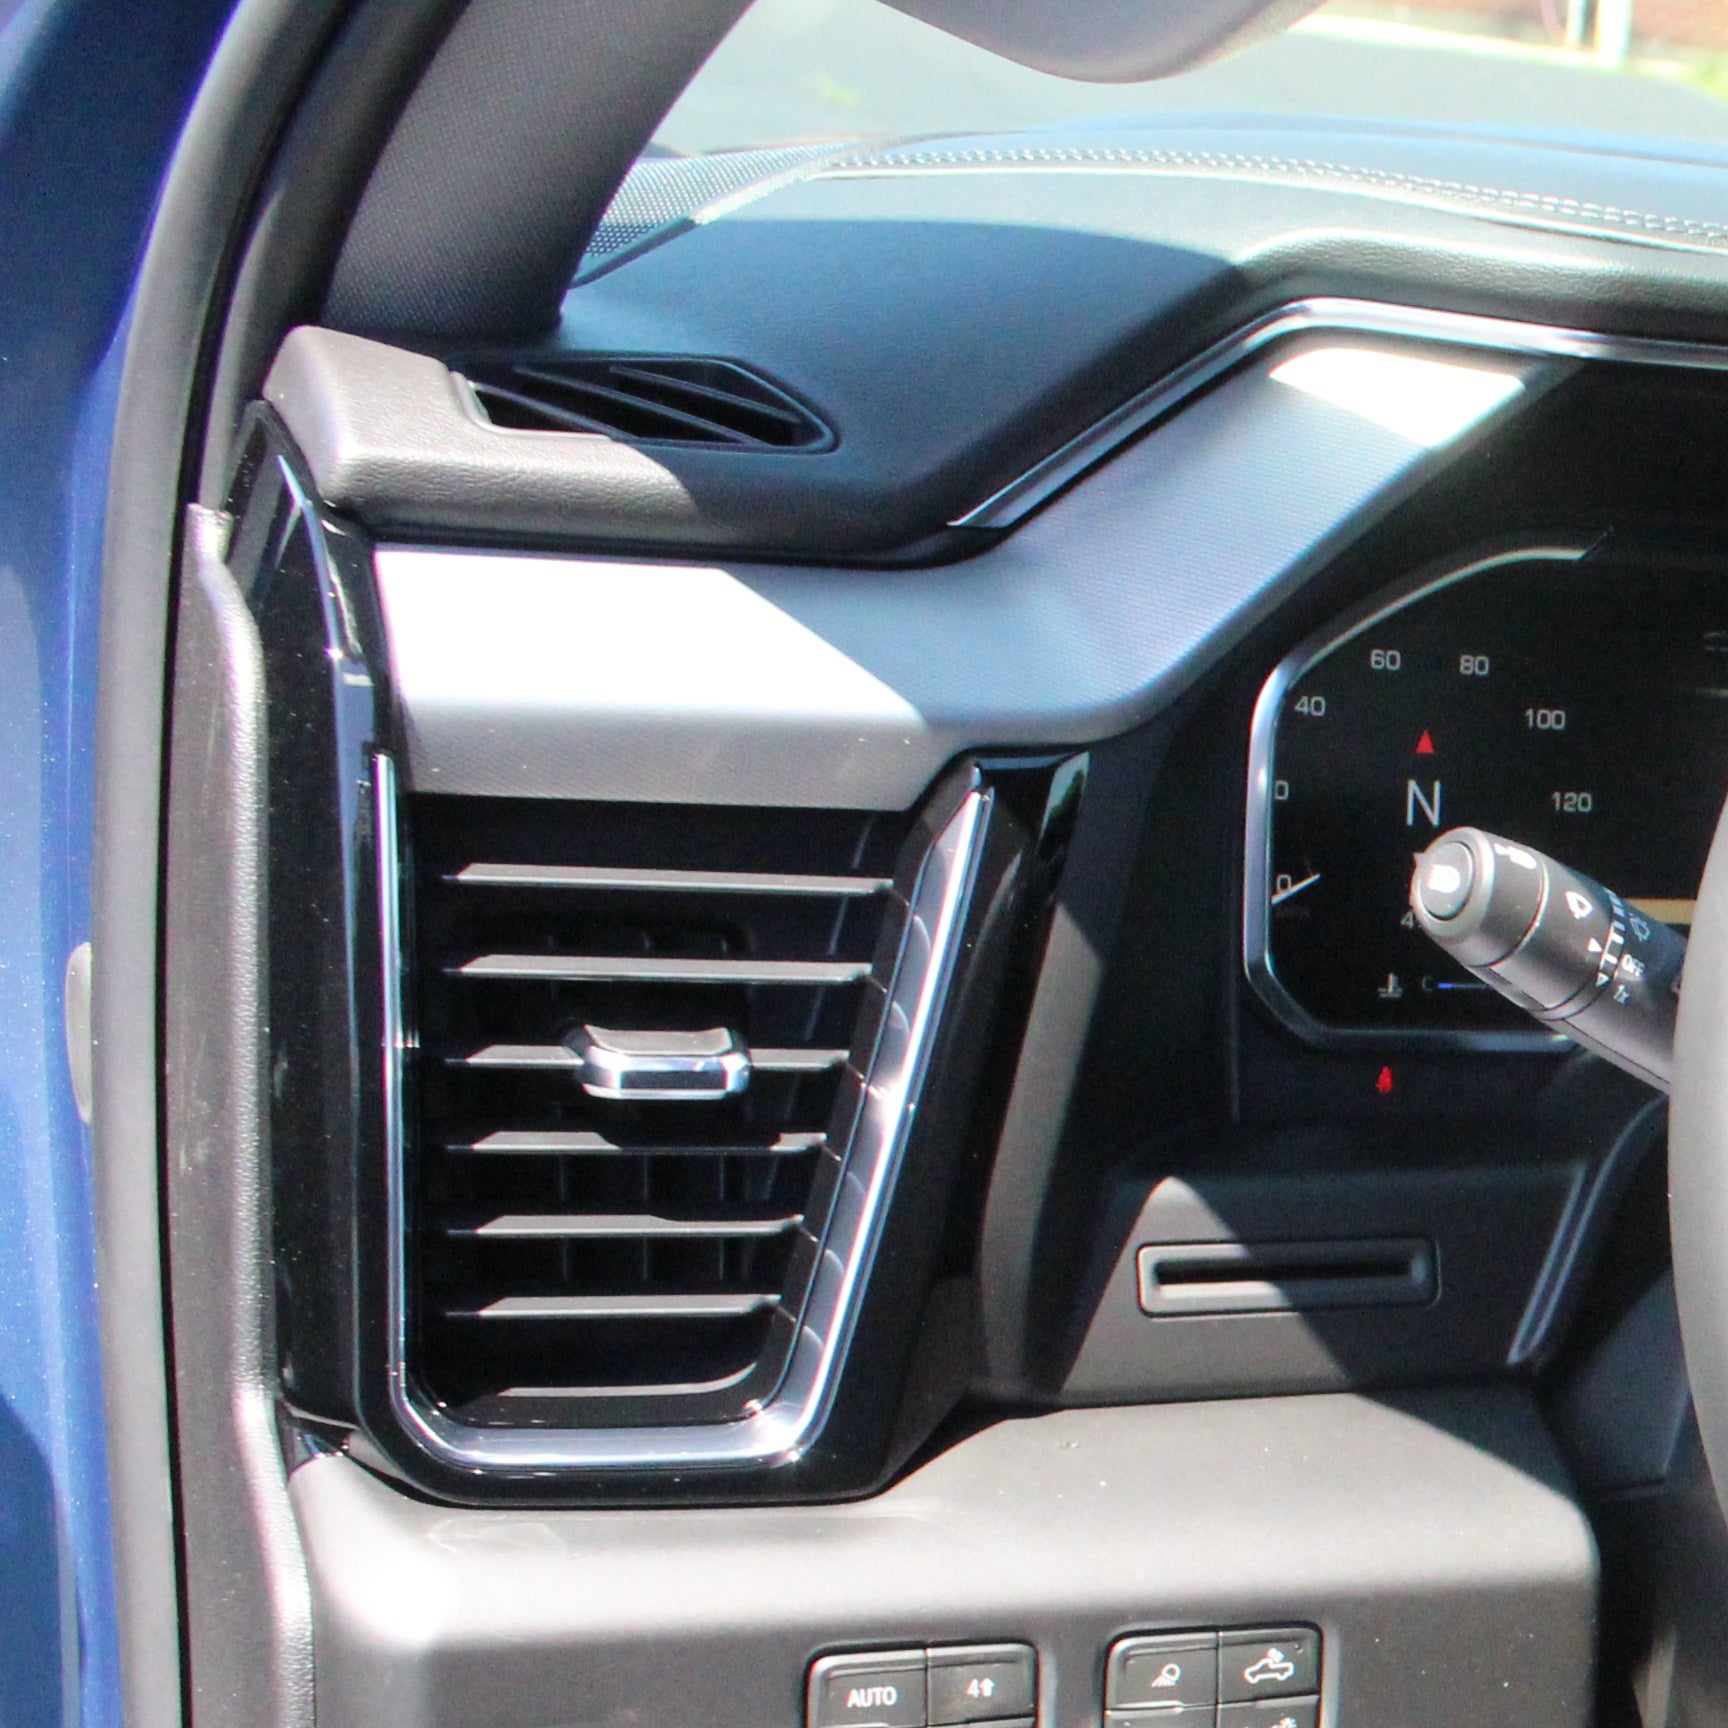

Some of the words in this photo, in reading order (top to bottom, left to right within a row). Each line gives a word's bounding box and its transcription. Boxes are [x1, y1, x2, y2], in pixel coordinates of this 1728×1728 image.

[1370, 649, 1401, 671] 60
[1459, 655, 1489, 676] 80
[1294, 696, 1326, 717] 40
[1524, 708, 1566, 730] 100
[1406, 779, 1441, 826] N
[1552, 791, 1593, 813] 120
[847, 1686, 897, 1708] AUTO
